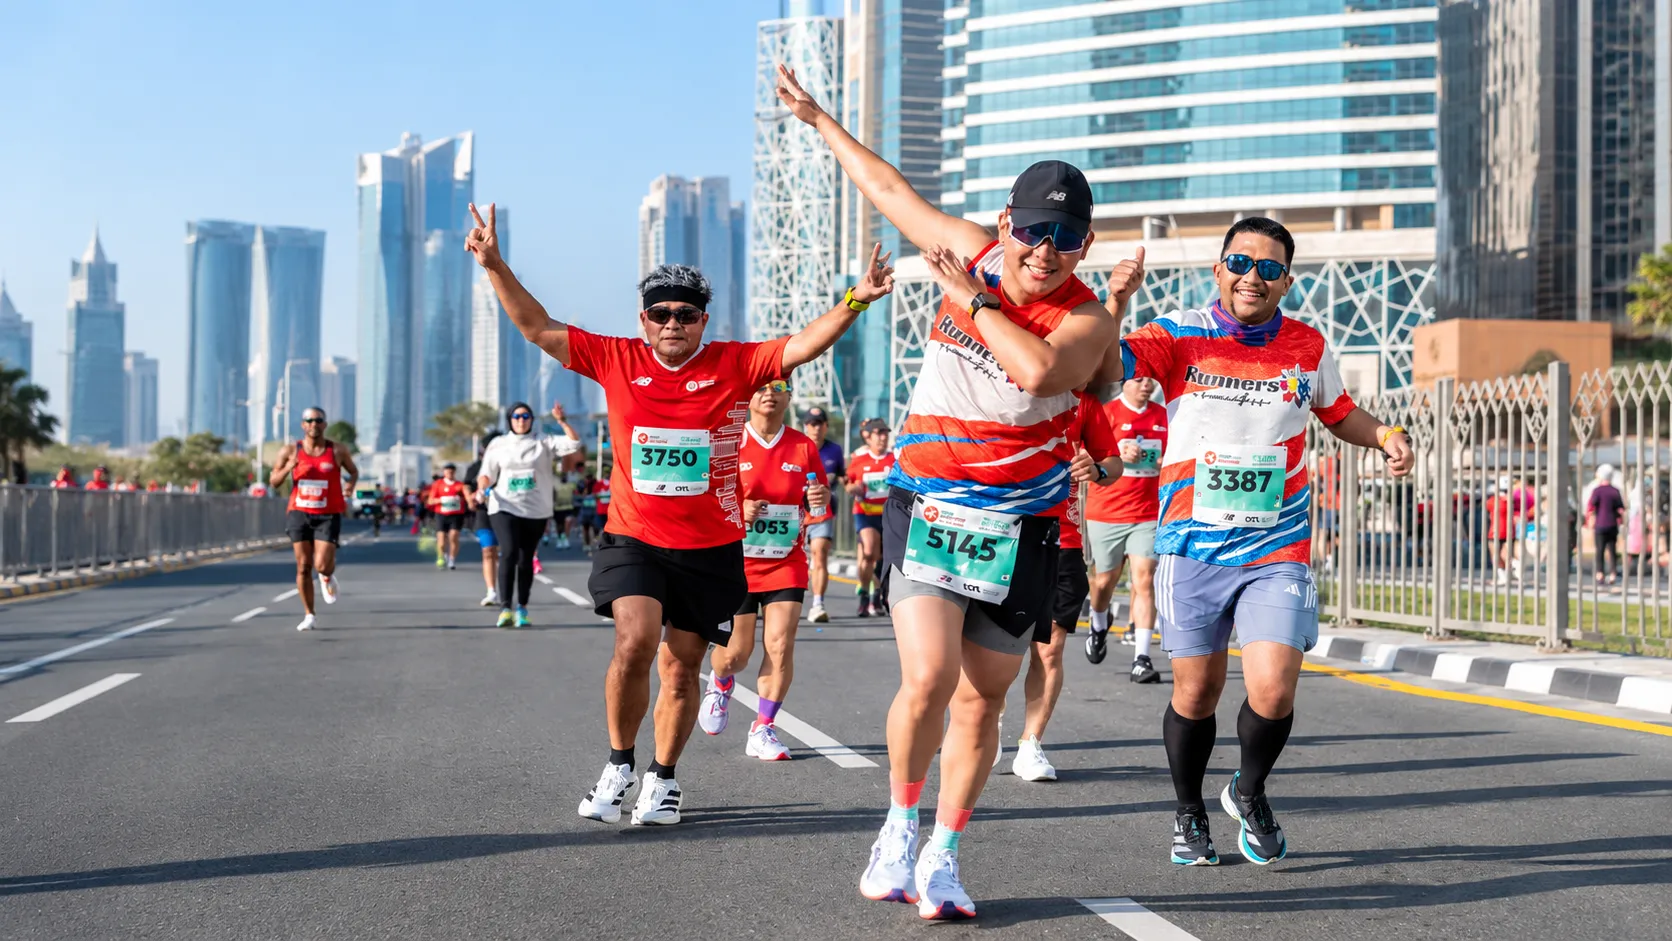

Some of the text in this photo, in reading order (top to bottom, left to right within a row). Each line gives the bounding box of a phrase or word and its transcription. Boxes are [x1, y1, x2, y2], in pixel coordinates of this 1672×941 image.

[938, 314, 1004, 372] Runne
[1184, 365, 1280, 393] Runners
[641, 447, 698, 467] 3750
[1206, 468, 1273, 493] 3387
[746, 520, 789, 535] 053
[926, 526, 998, 562] 5145
